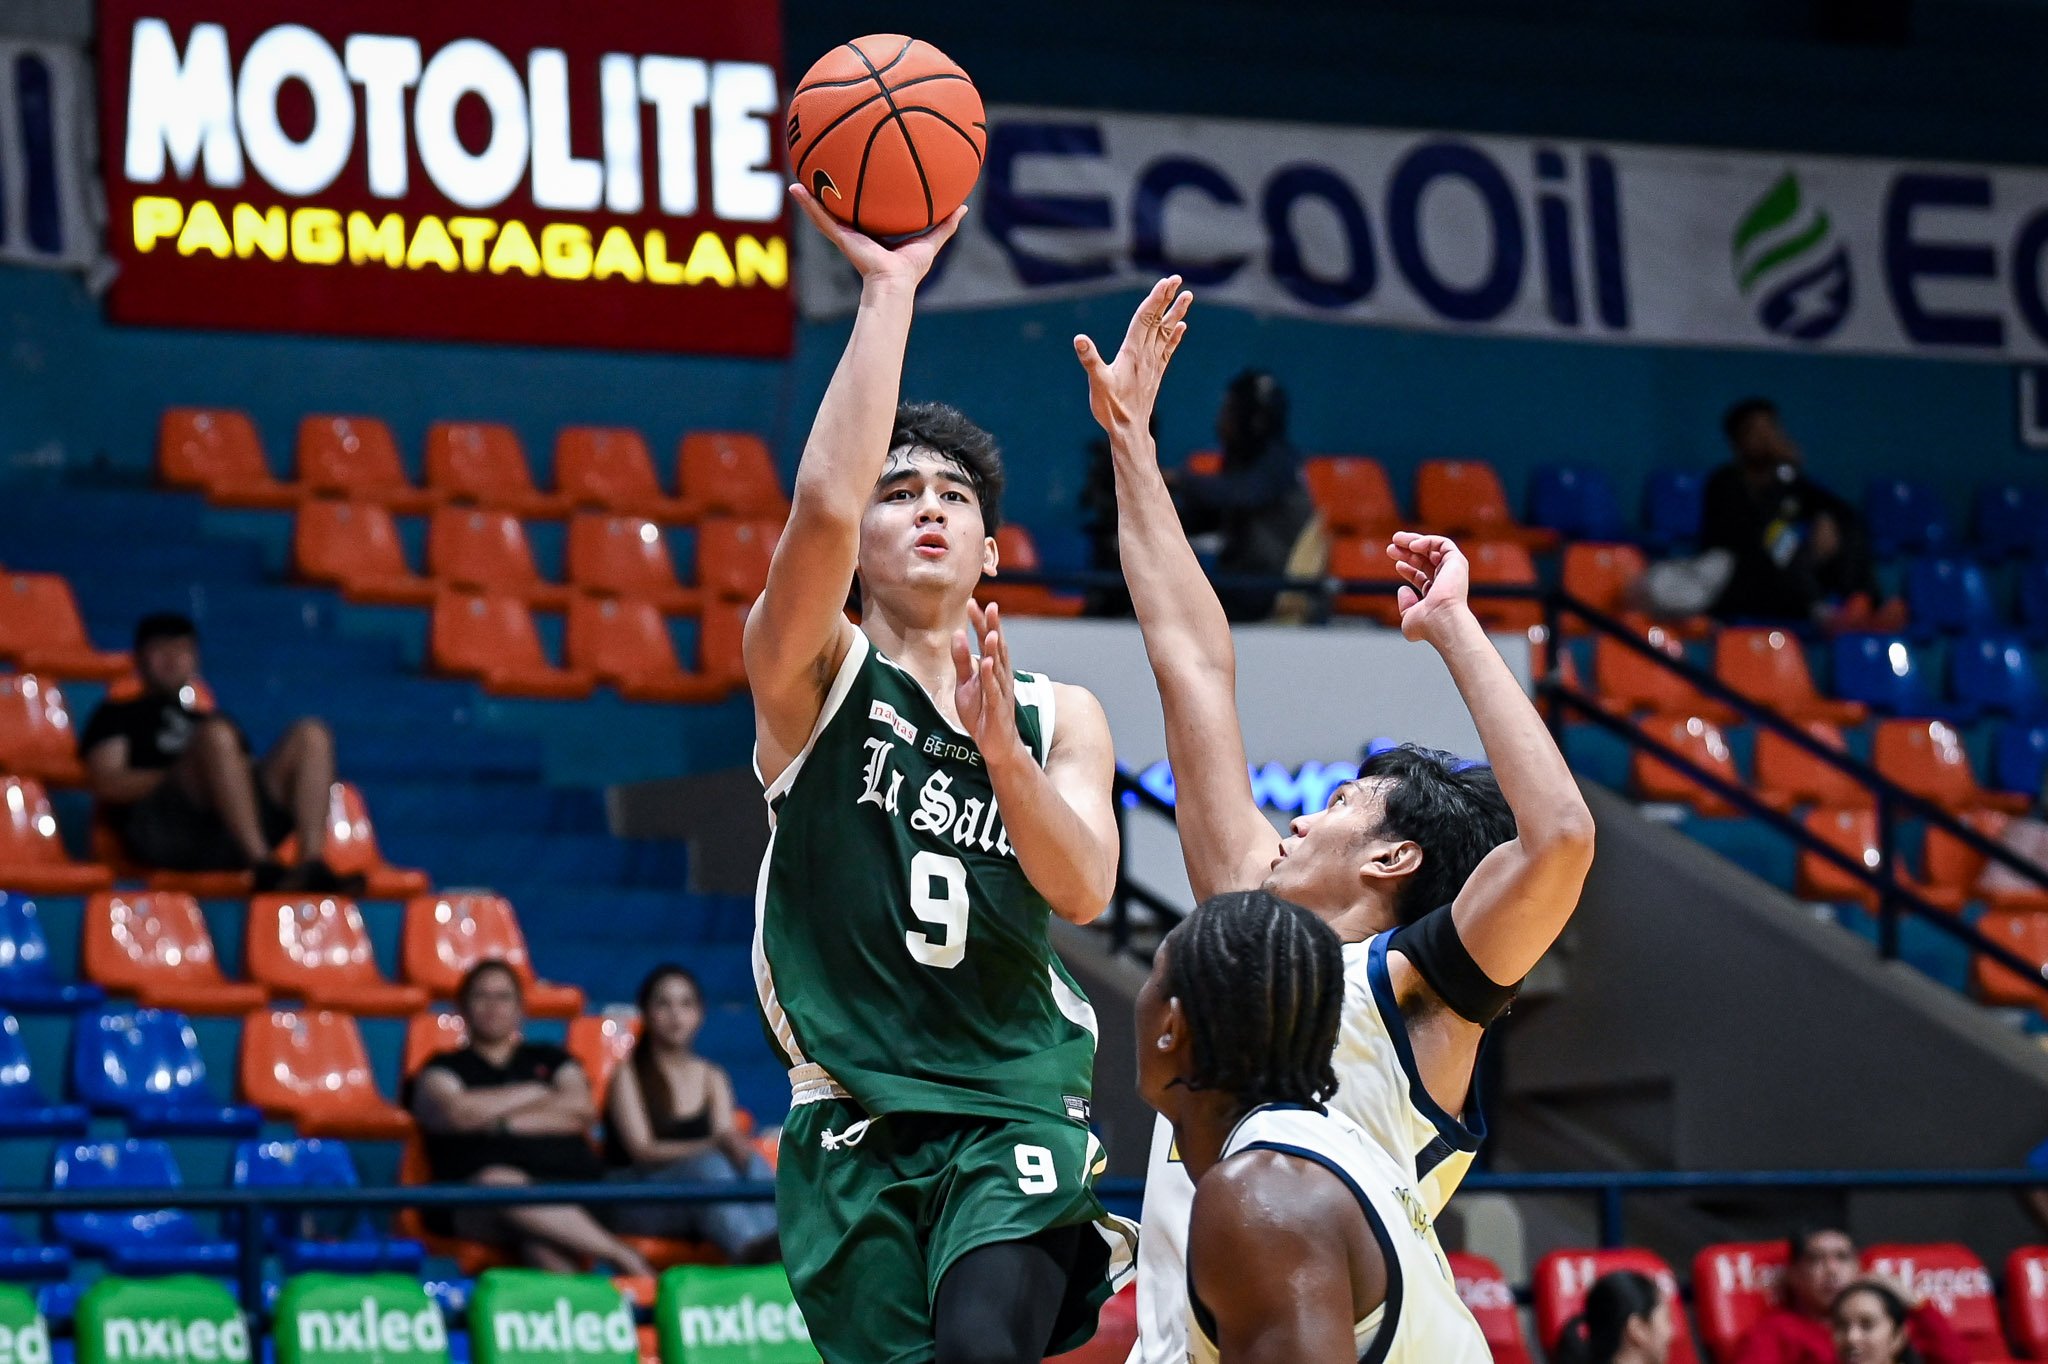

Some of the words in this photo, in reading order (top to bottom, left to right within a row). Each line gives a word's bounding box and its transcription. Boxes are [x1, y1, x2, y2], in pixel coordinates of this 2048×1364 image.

[124, 17, 784, 222] MOTOLITE
[132, 196, 788, 289] PANGMATAGALAN
[981, 120, 1630, 331] EcoOil
[857, 737, 905, 816] La
[905, 850, 970, 969] 9
[1014, 1143, 1058, 1195] 9
[297, 1295, 447, 1351] nxled
[493, 1289, 640, 1353] nxled
